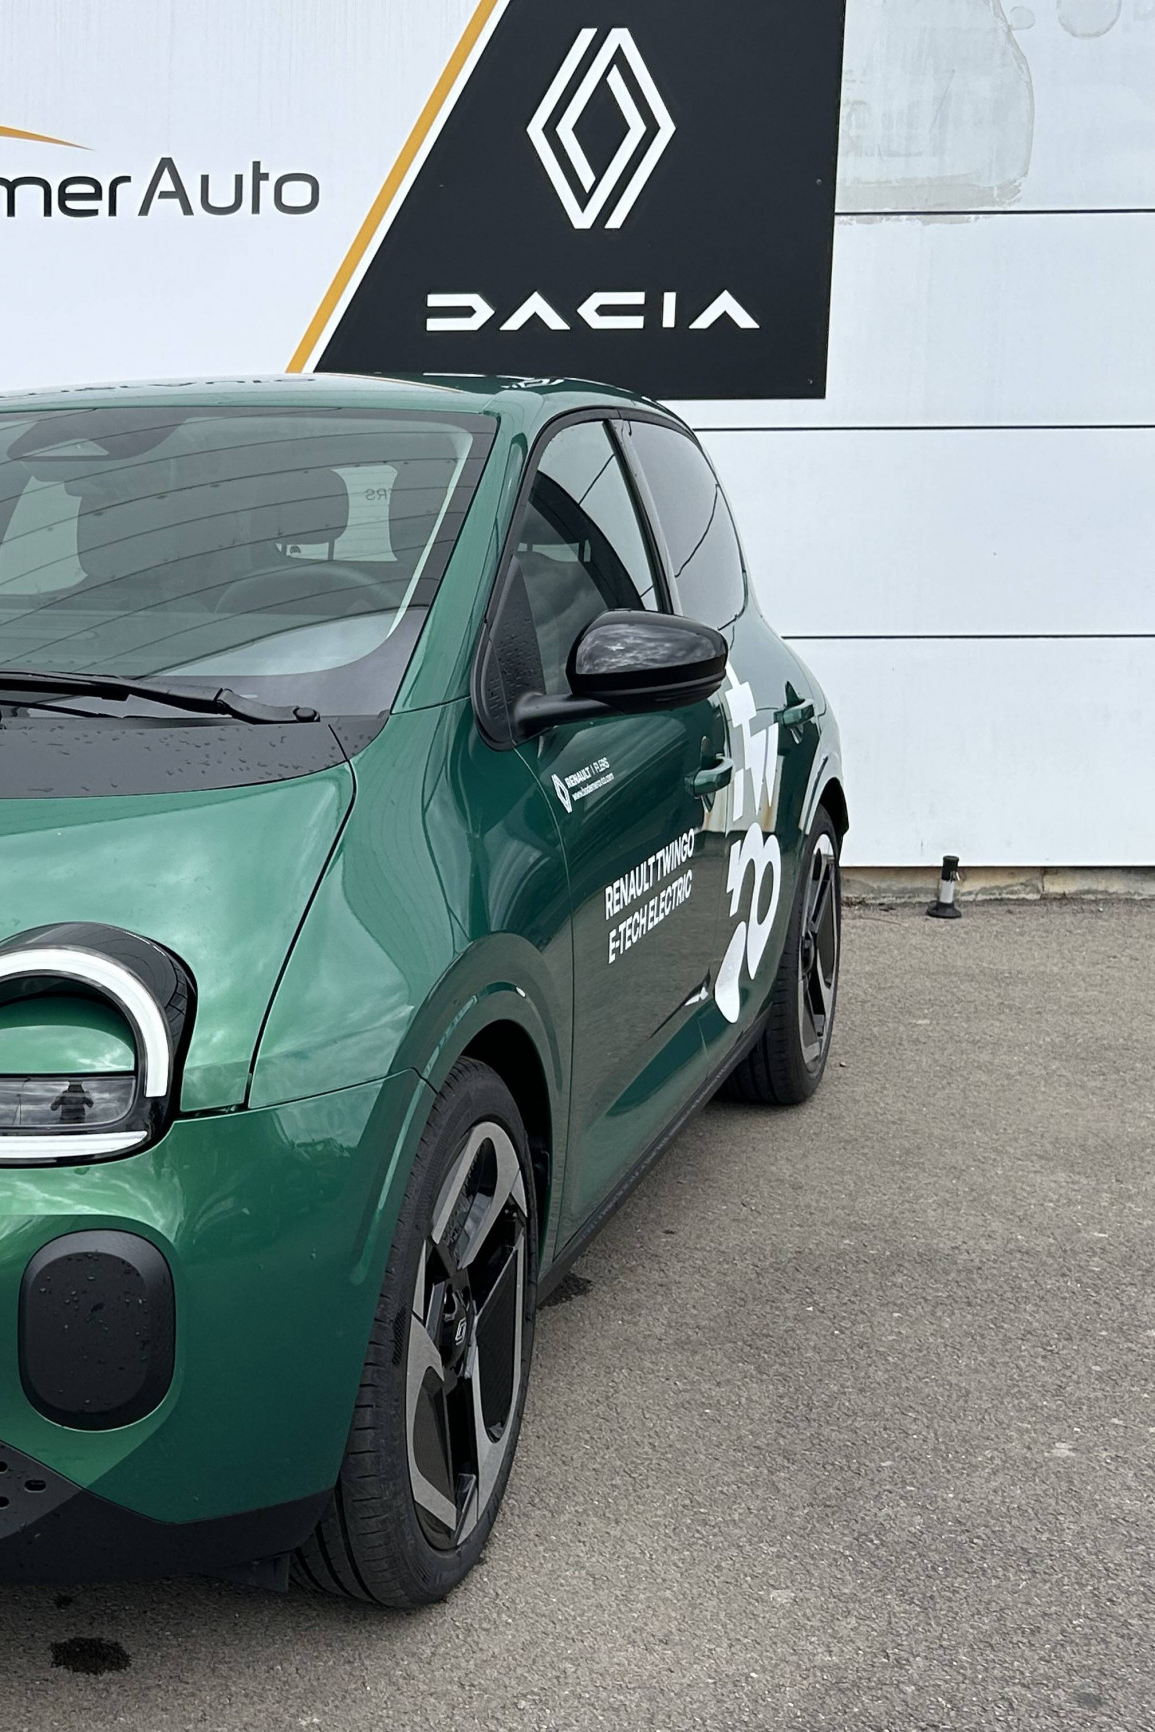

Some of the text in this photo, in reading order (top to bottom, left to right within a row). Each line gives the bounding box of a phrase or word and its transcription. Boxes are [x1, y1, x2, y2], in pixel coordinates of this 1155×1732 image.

[426, 289, 760, 332] DACIA
[605, 828, 695, 920] RENAULT TWINGO
[608, 869, 693, 964] E-TECH ELECTRIC
